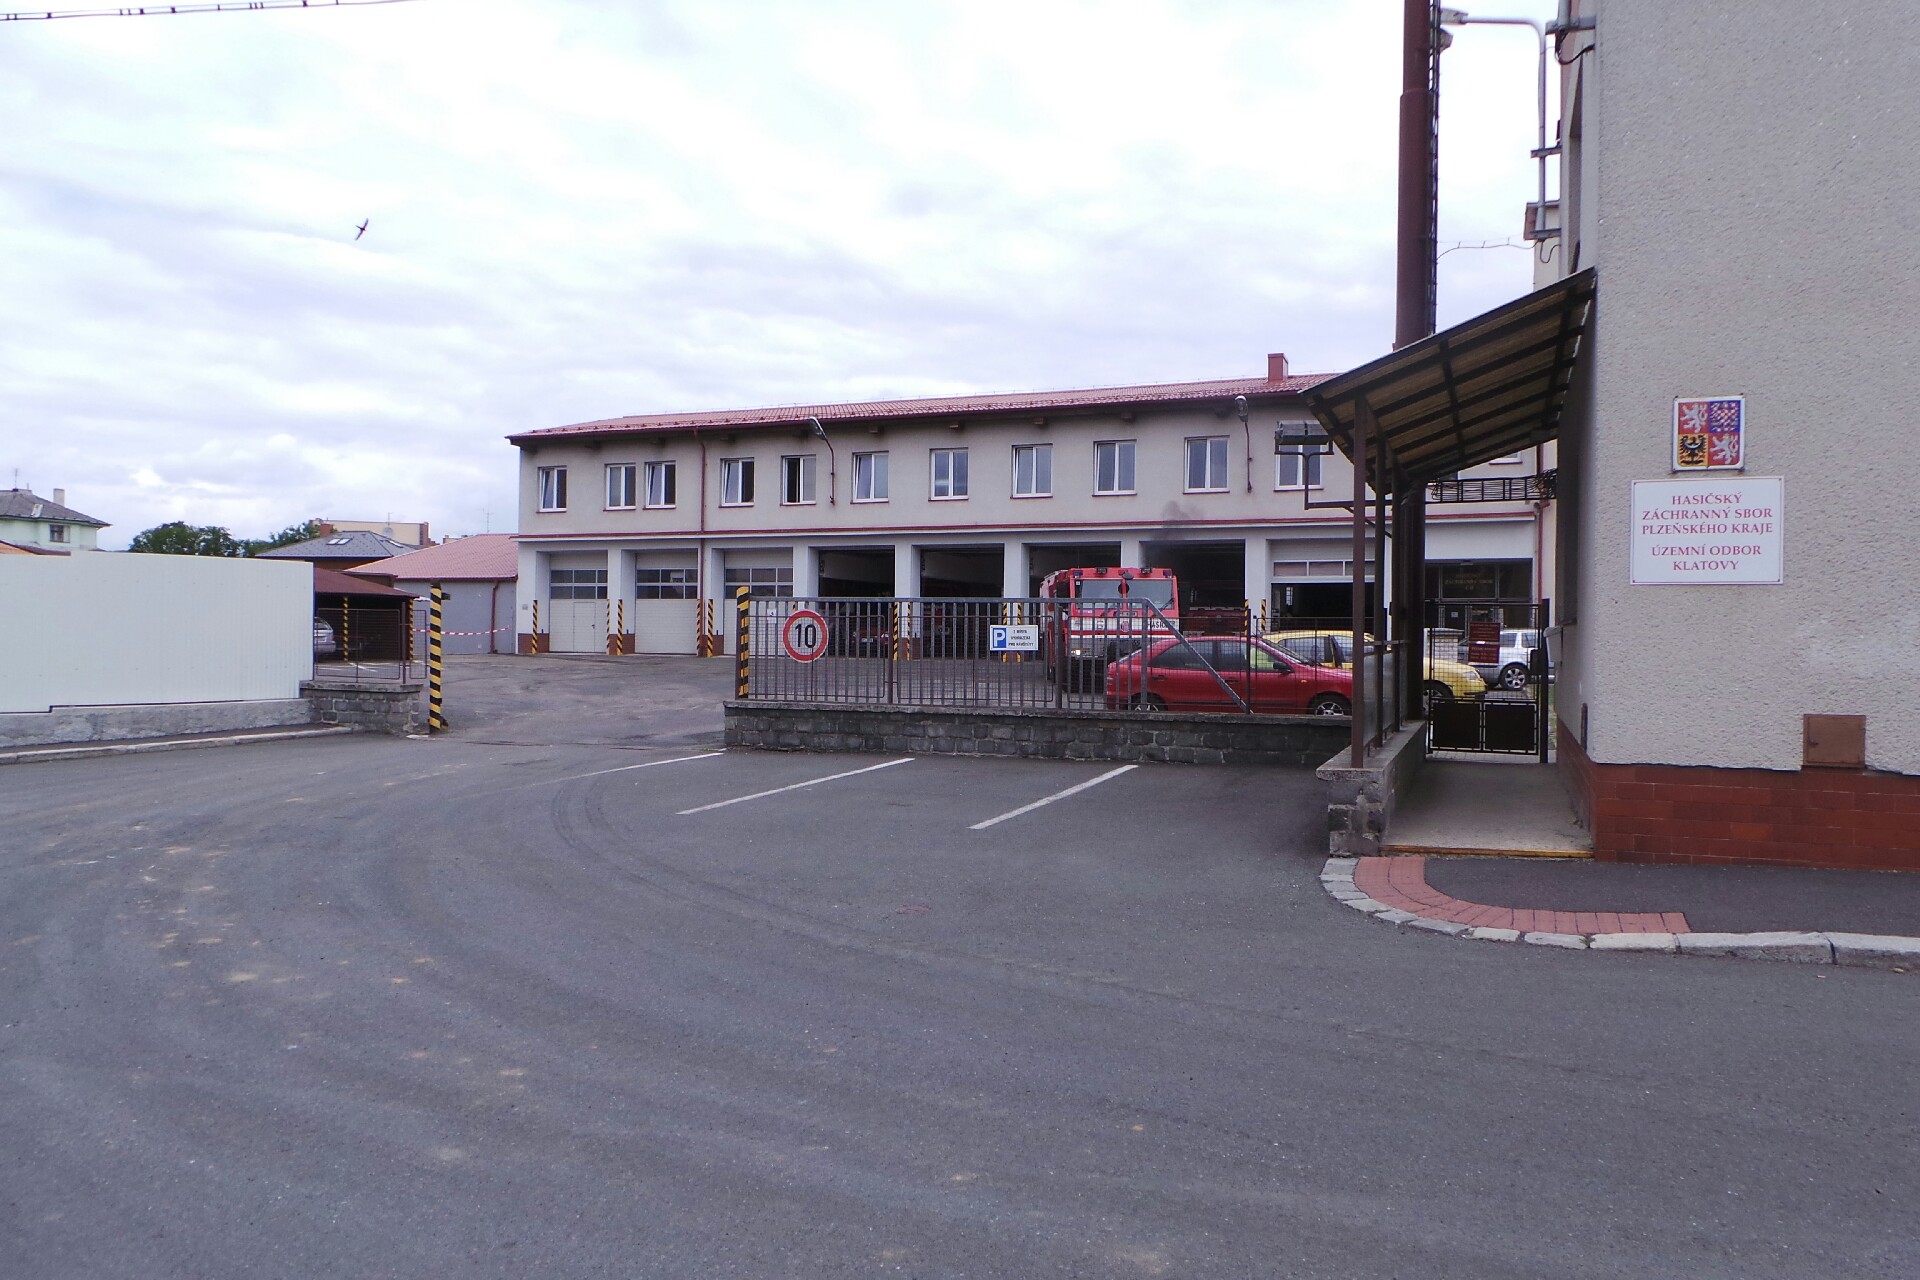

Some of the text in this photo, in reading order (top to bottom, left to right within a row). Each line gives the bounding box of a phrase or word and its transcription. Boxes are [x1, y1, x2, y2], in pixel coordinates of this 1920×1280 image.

[1672, 492, 1742, 505] HASIČSKÝ
[1642, 507, 1772, 520] ZÁCHRANNÝ SBOR
[1642, 521, 1773, 535] PLZEŇSKÉHO KRAJE
[1651, 544, 1761, 556] ÚZEMNÍ ODBOR
[1673, 560, 1739, 570] KLATOVY
[795, 623, 817, 648] 10
[993, 629, 1006, 647] P
